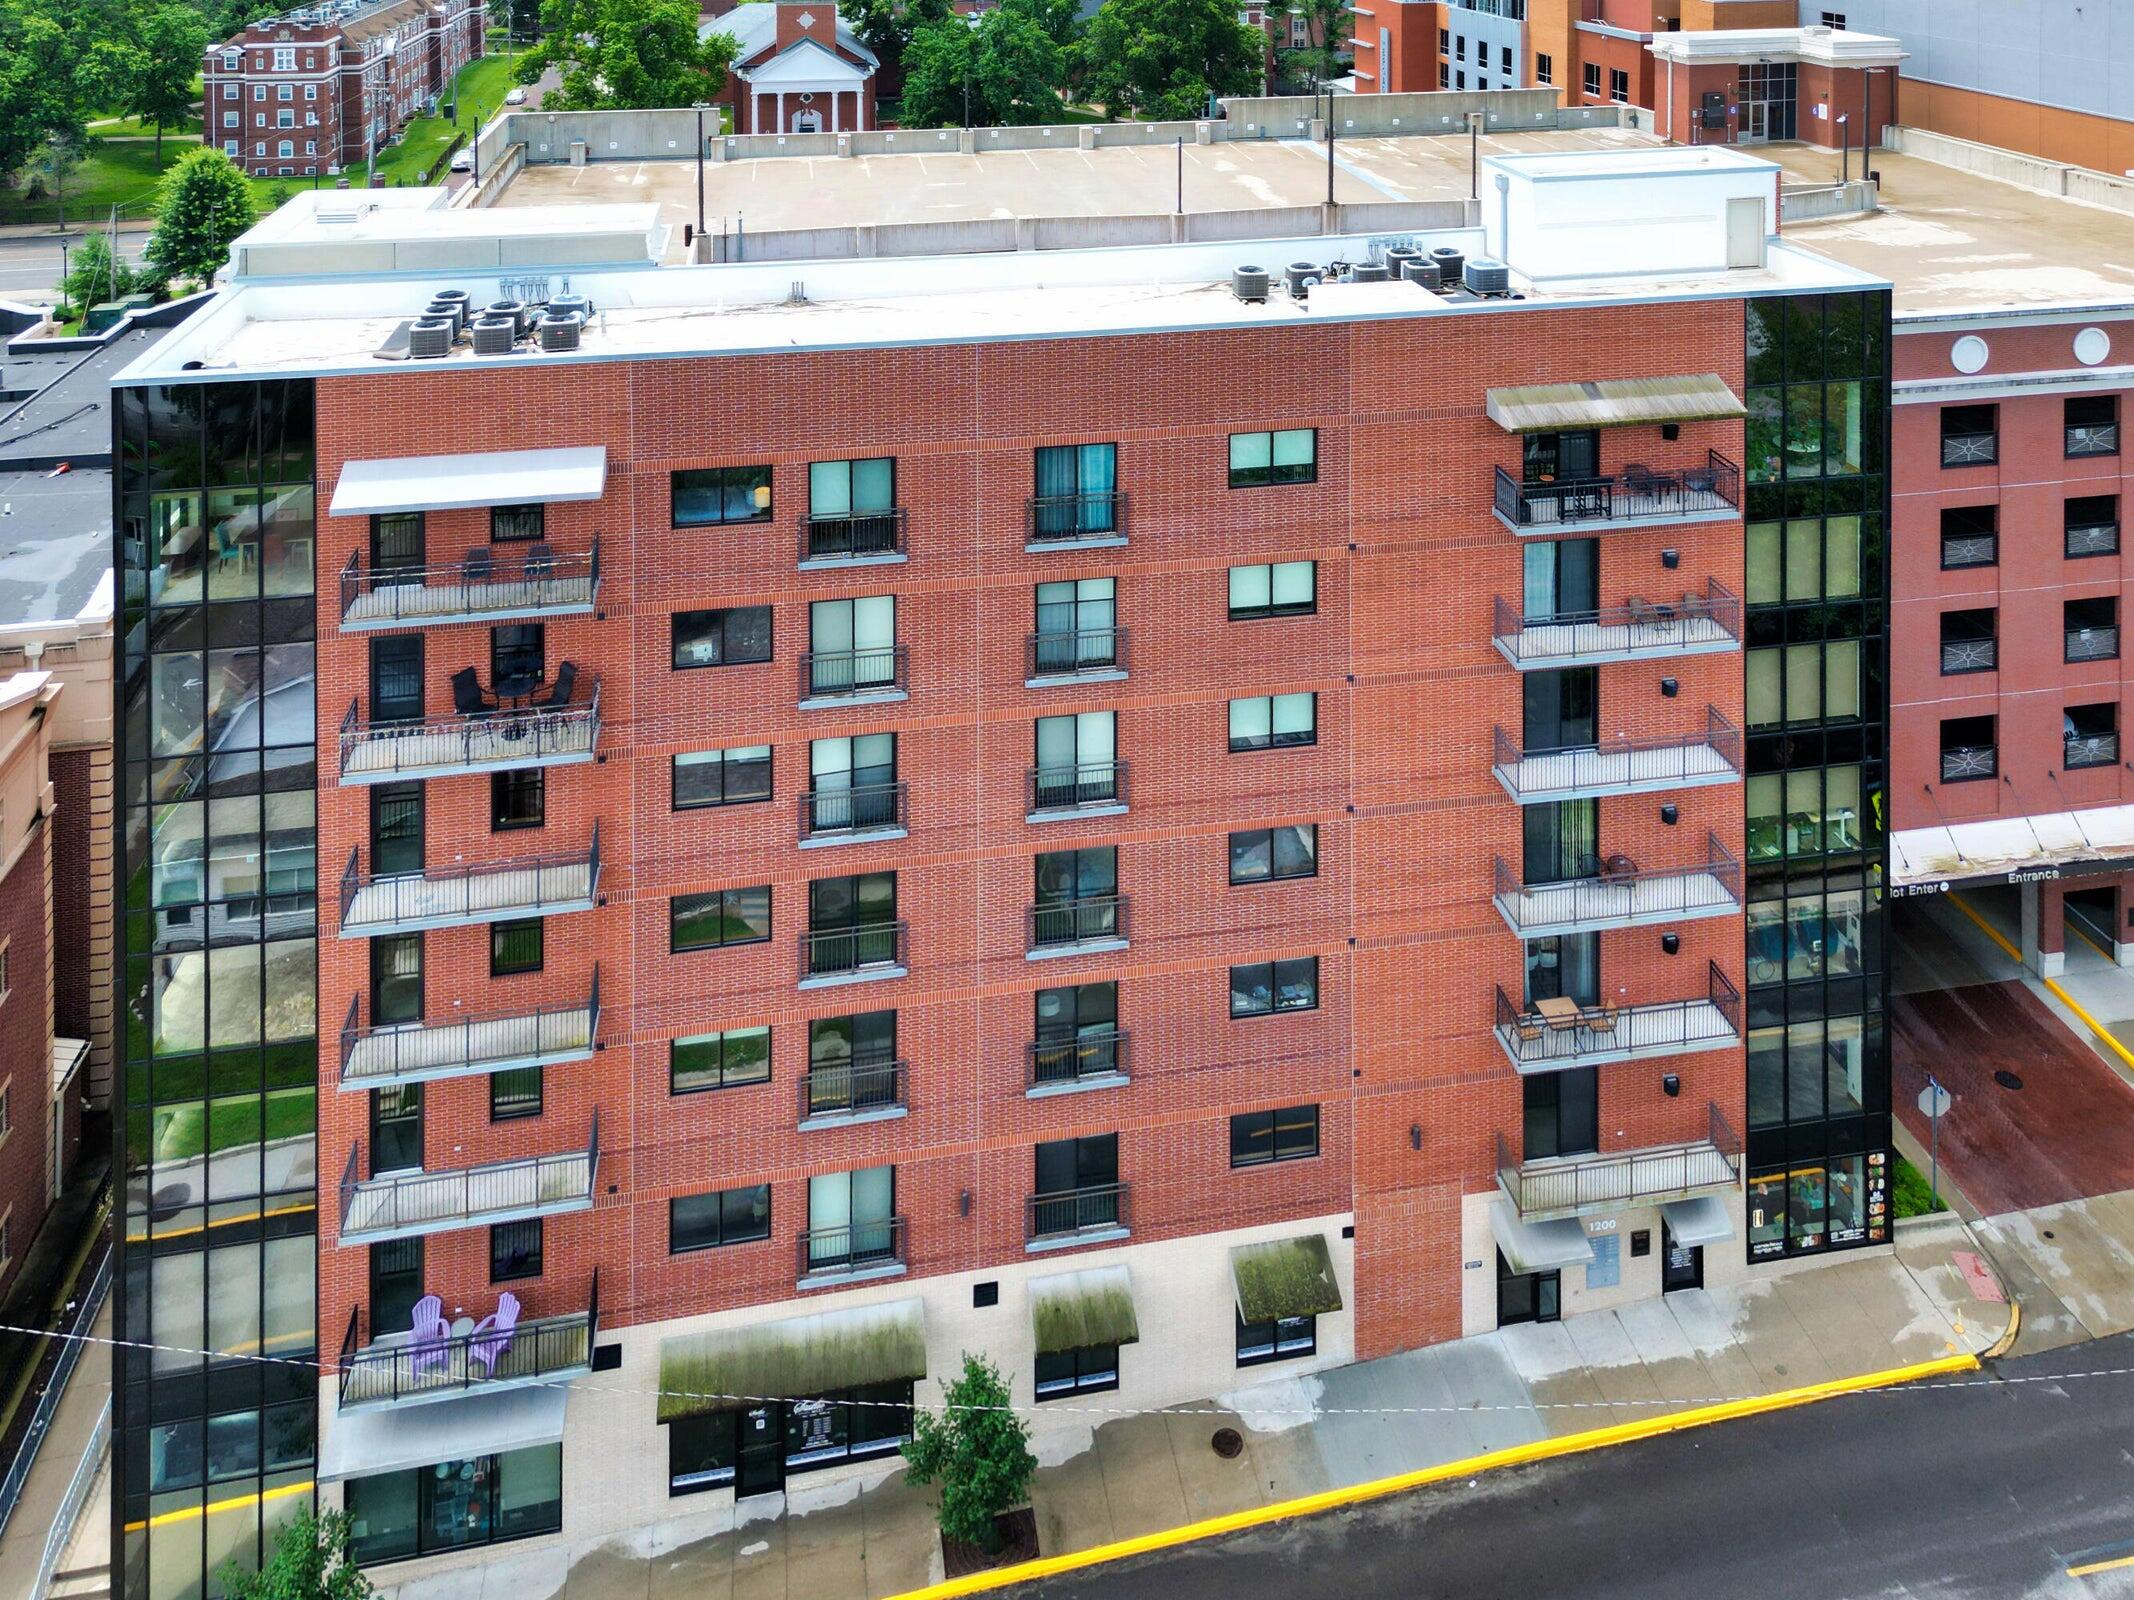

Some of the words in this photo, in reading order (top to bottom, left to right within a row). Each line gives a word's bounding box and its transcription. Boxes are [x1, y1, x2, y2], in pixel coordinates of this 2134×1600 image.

[2008, 869, 2060, 884] Entrance
[1909, 884, 1939, 896] Enter
[1590, 1219, 1617, 1232] 1200
